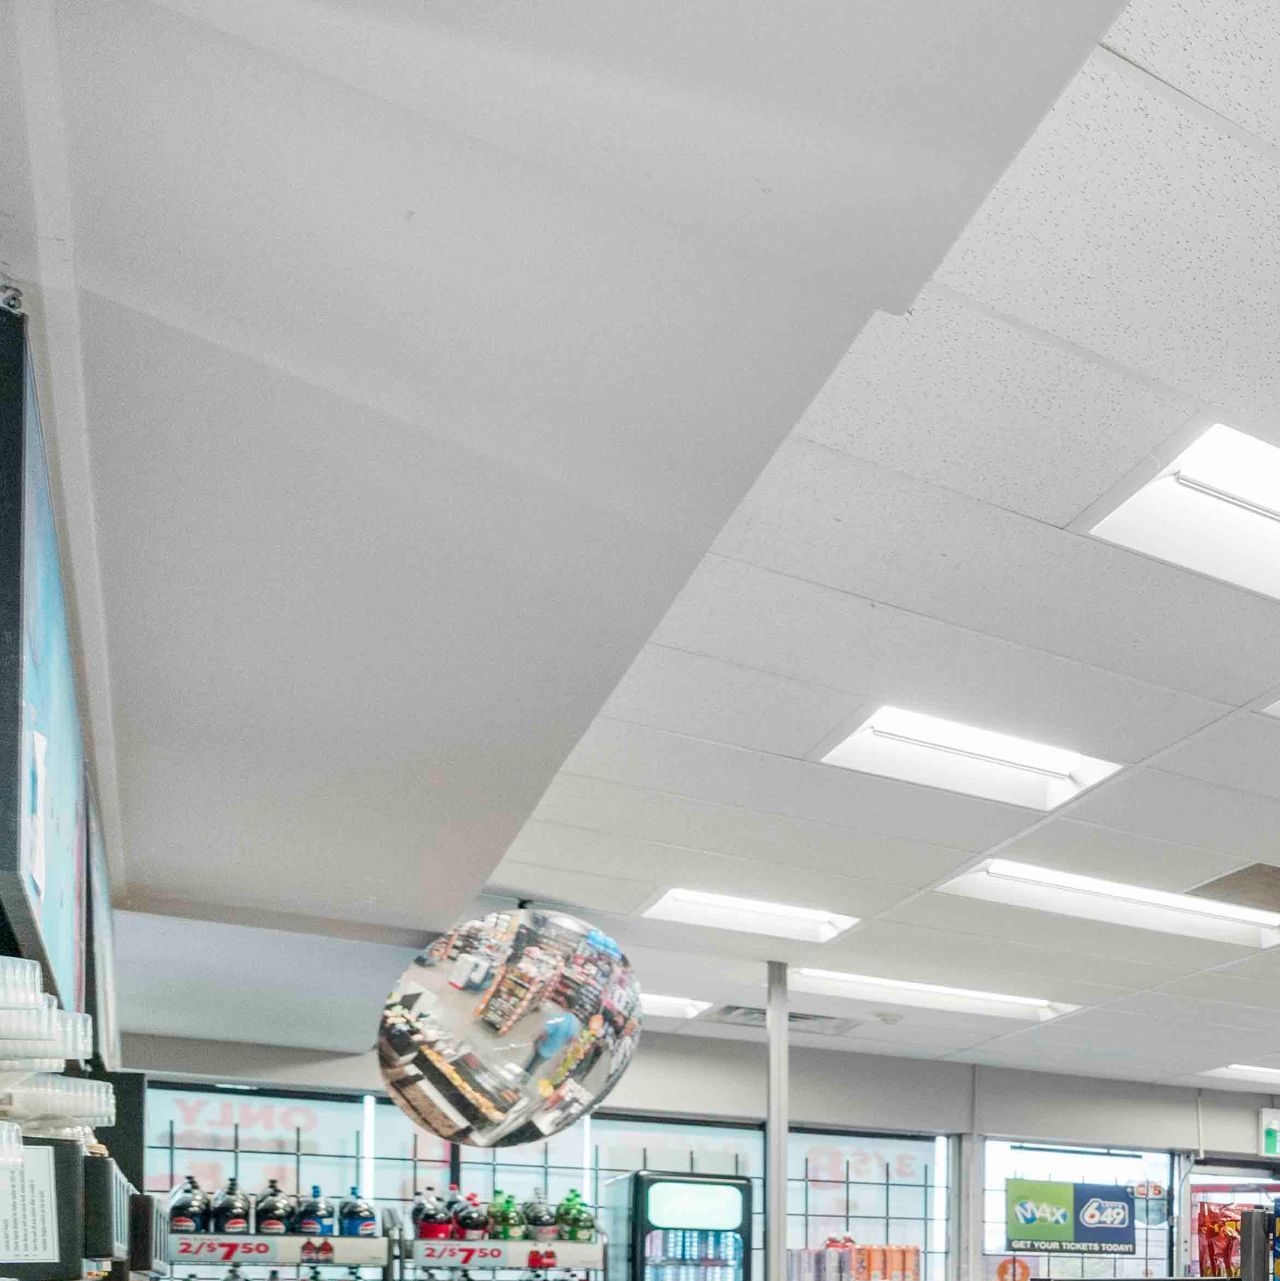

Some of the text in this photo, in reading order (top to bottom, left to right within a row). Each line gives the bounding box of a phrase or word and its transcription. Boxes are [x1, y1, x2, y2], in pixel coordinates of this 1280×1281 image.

[1013, 1200, 1069, 1226] MAX
[1011, 1240, 1134, 1252] GET YOUR TICKETS TODAY!
